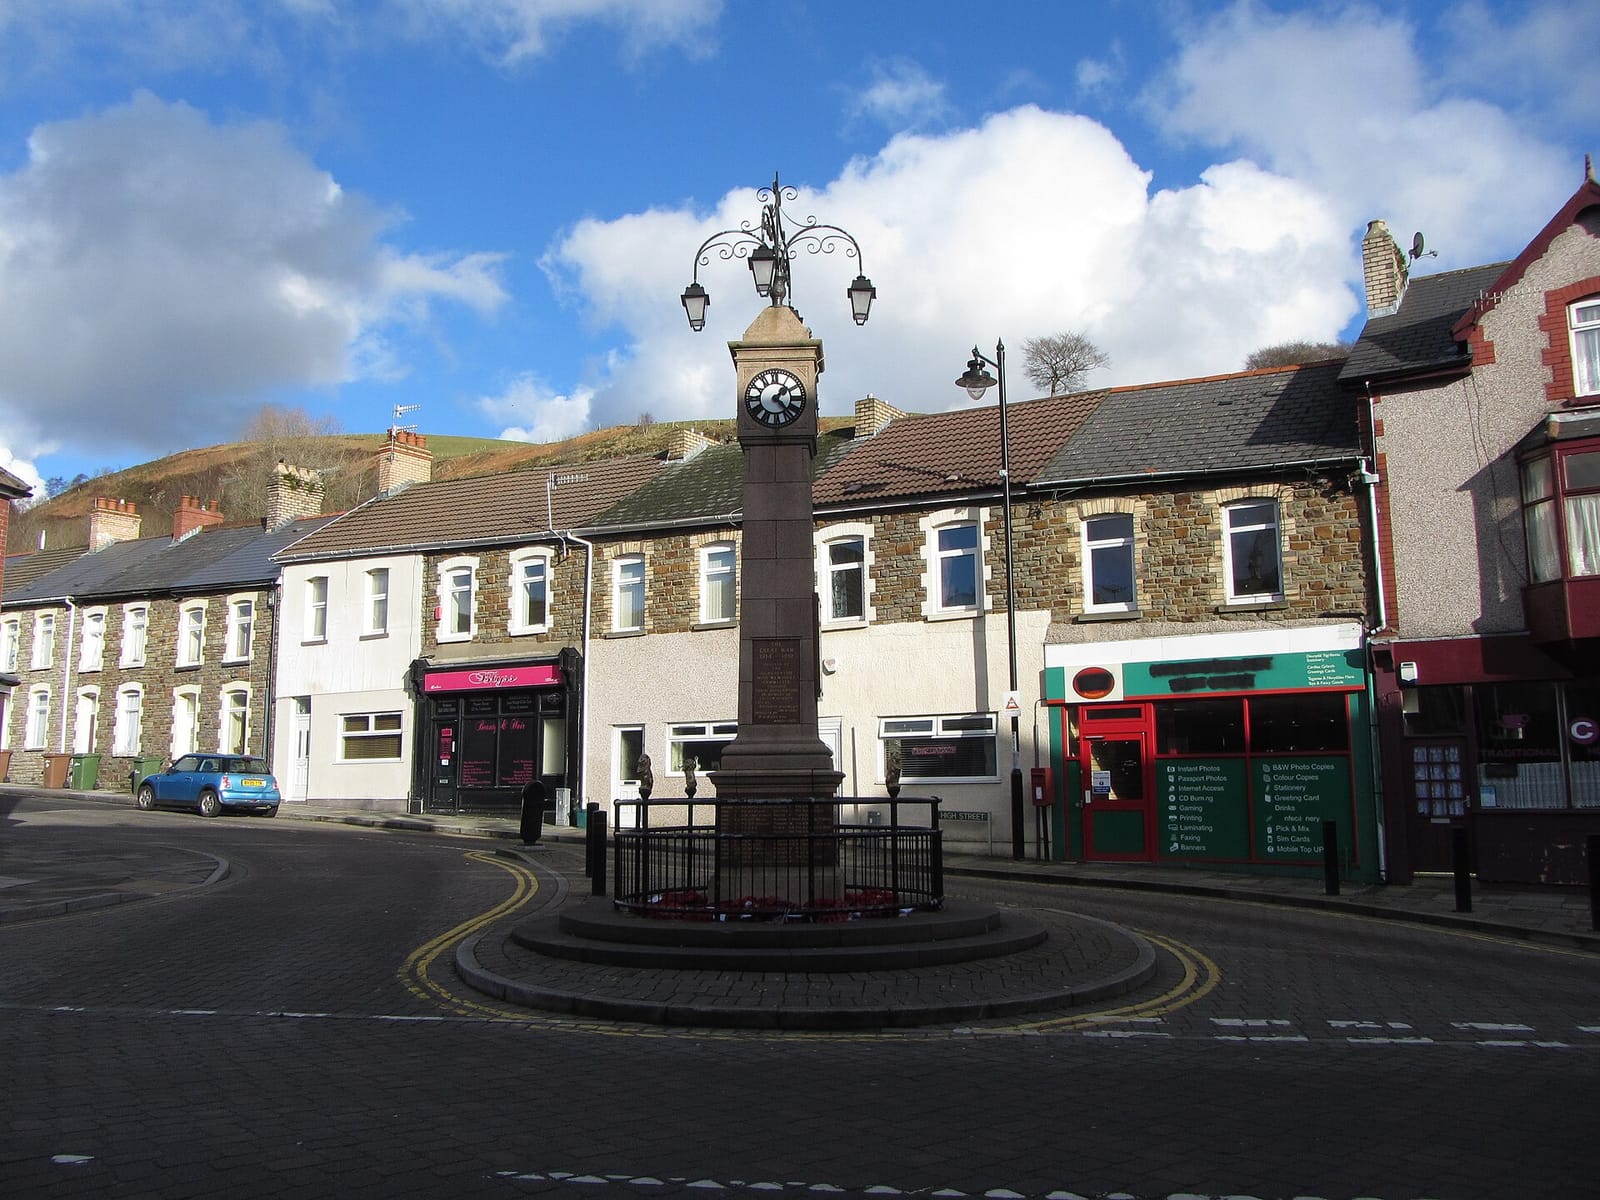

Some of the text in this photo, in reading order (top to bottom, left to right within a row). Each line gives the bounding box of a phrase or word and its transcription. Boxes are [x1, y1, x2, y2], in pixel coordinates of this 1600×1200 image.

[1311, 763, 1335, 771] Copies
[1296, 774, 1319, 782] Copies
[1274, 784, 1306, 792] Stationery
[1274, 794, 1302, 802] Greeting
[940, 811, 985, 821] HIGH STREET
[1180, 814, 1202, 822] Printing
[1180, 824, 1213, 832] Laminating
[1180, 834, 1200, 842] Faxing
[1300, 846, 1312, 854] Top
